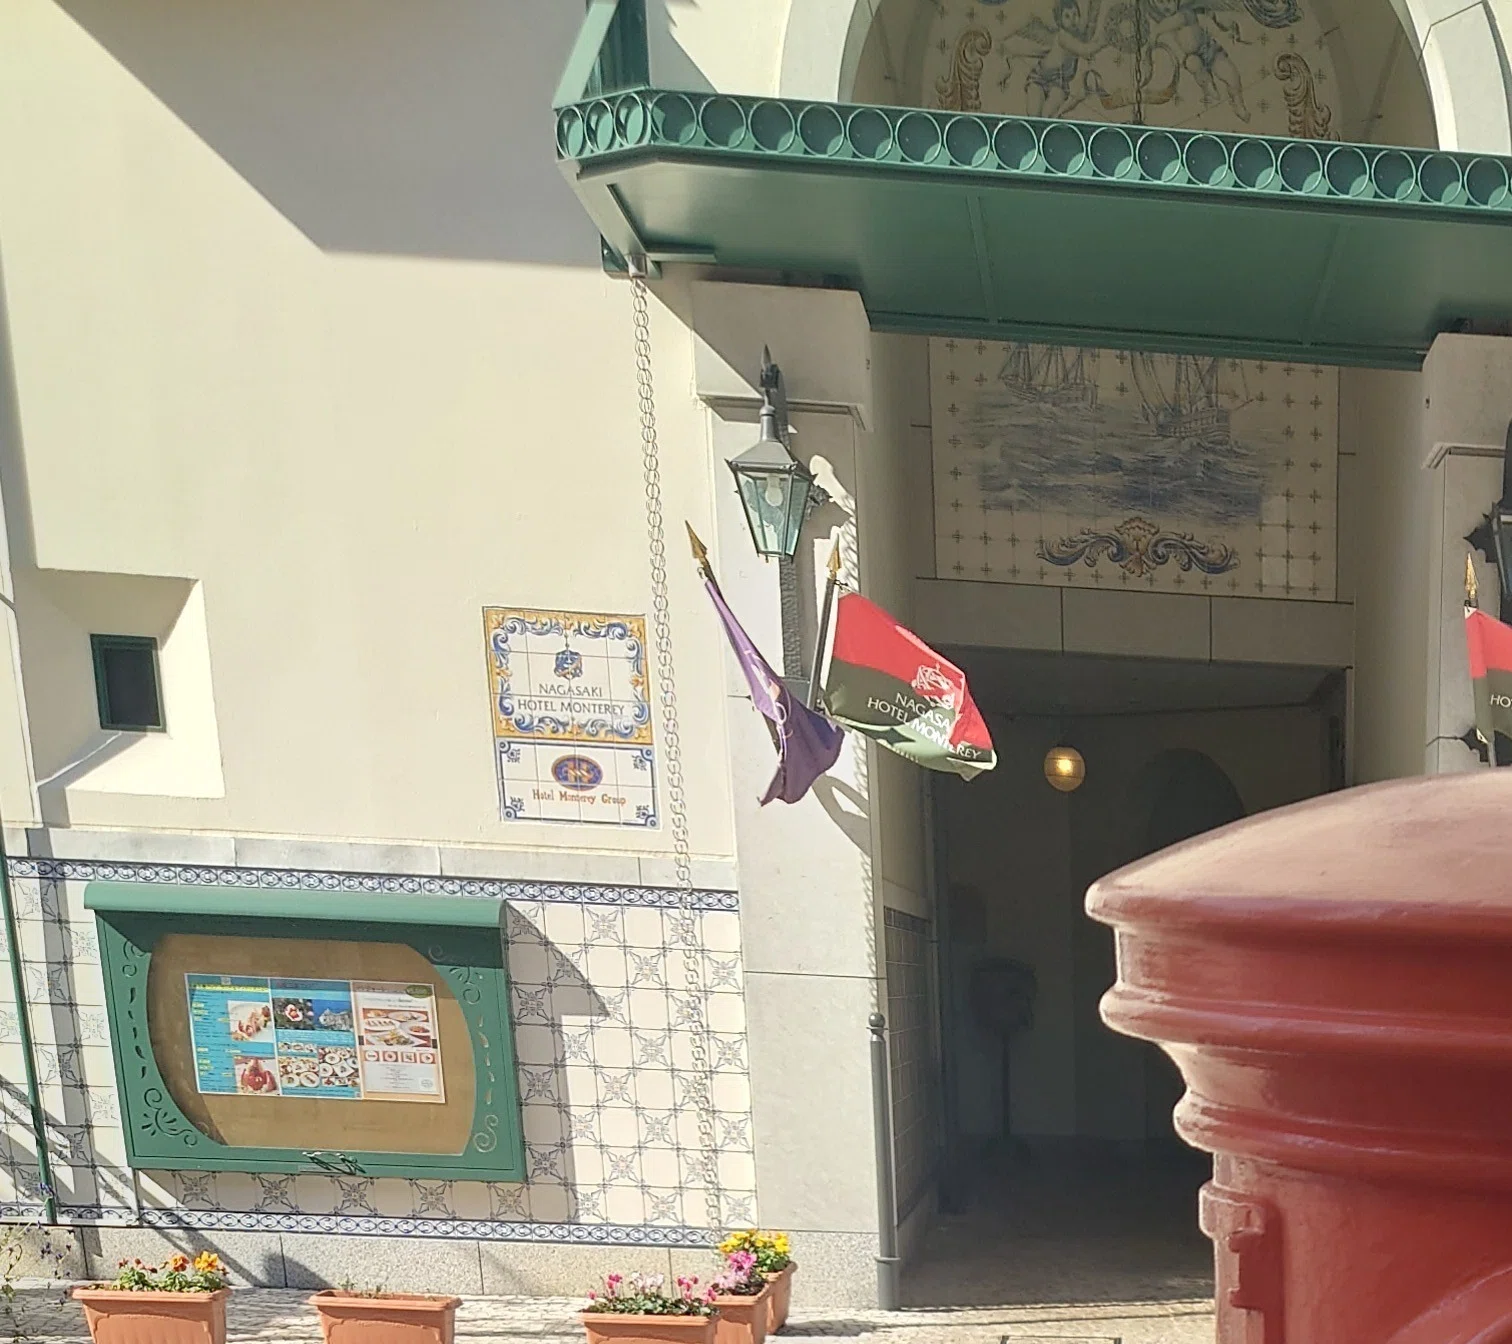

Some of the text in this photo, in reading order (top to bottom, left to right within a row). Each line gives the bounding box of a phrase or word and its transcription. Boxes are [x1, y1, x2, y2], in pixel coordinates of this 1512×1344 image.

[538, 683, 603, 697] NAGASAKI
[517, 699, 626, 716] HOTEL MONTEREY
[867, 697, 912, 726] HOTEL
[532, 788, 627, 806] Hotel Monterey Group
